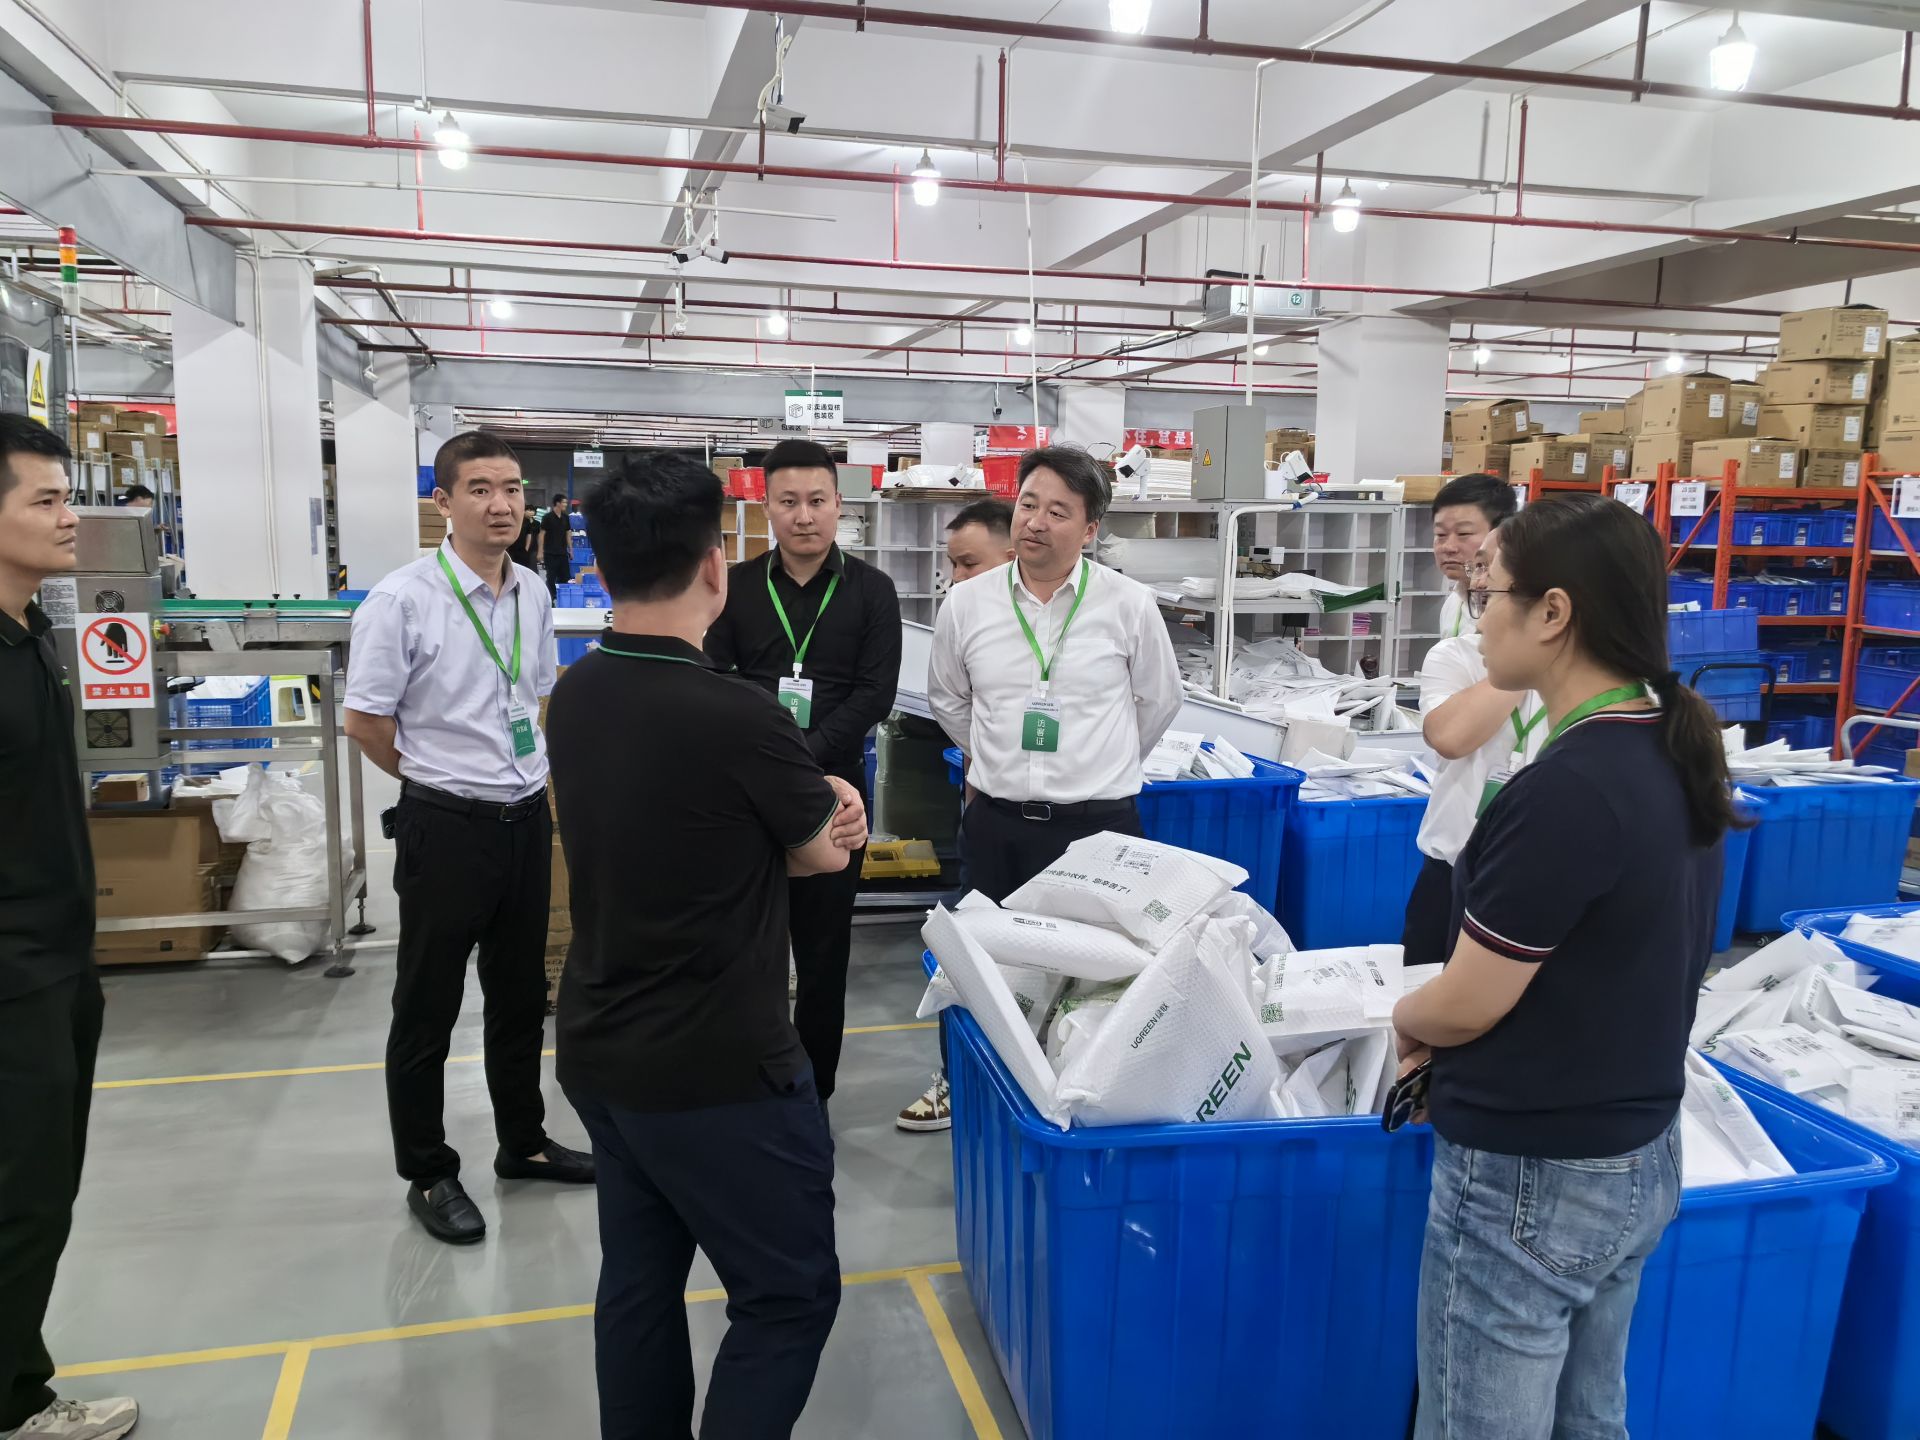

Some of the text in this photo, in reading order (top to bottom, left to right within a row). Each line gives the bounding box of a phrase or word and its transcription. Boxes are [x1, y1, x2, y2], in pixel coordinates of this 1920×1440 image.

[1291, 295, 1301, 304] 12
[1036, 719, 1045, 745] 访客证
[1131, 1016, 1158, 1049] UGREEN
[1192, 1041, 1252, 1122] REEN
